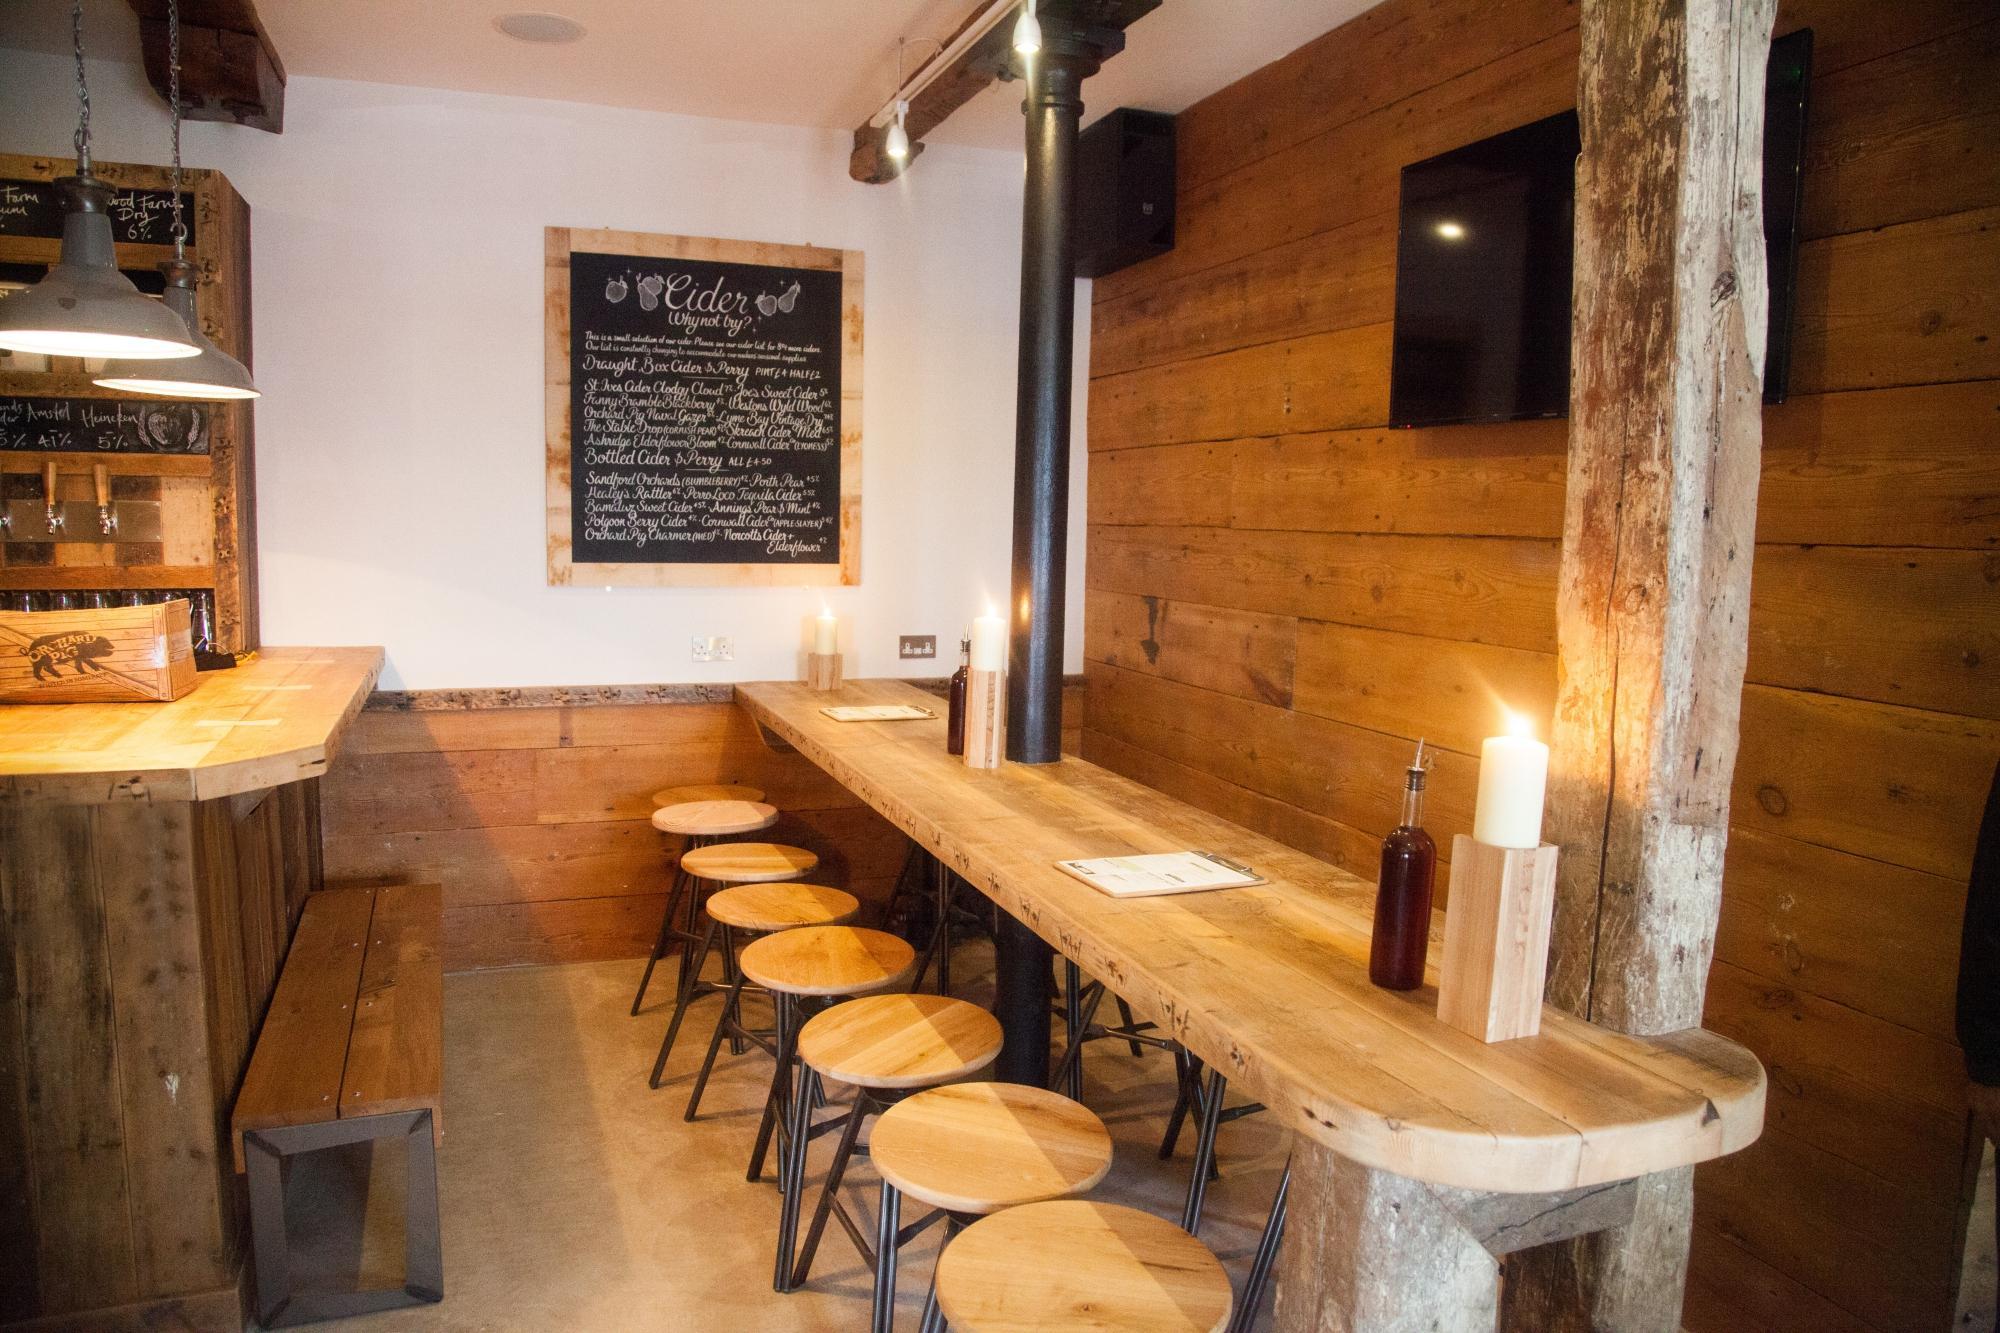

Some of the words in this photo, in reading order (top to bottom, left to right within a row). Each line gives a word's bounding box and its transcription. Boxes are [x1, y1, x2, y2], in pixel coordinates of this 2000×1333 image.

[117, 208, 160, 226] Dry
[128, 224, 152, 240] 6%
[665, 272, 749, 314] Cider
[668, 312, 700, 334] Why
[700, 313, 722, 328] not
[723, 314, 752, 336] try?
[585, 331, 599, 340] This
[614, 333, 630, 342] small
[632, 334, 657, 343] selection
[659, 334, 665, 344] of
[694, 336, 714, 346] Please
[738, 340, 753, 348] cider
[755, 340, 765, 350] list
[585, 341, 599, 350] Our
[601, 341, 612, 351] list
[620, 344, 651, 355] constantly
[652, 346, 678, 357] changing
[679, 346, 685, 354] to
[583, 354, 638, 378] Draught
[640, 356, 670, 374] Box
[671, 359, 702, 373] Cider
[713, 361, 749, 384] Perry
[755, 367, 776, 376] PINT
[789, 369, 810, 378] HALF
[600, 378, 623, 392] Ives
[624, 380, 651, 393] Cider
[653, 380, 689, 400] Clodgy
[691, 382, 724, 396] Cloud
[761, 384, 793, 398] Sweet
[793, 386, 818, 399] Cider
[619, 393, 661, 407] Bramble
[662, 393, 715, 412] Blackberry
[729, 396, 768, 411] Westons
[769, 399, 795, 416] Wyld
[797, 400, 824, 412] Wood
[28, 402, 70, 423] Amstel
[80, 403, 138, 428] Heineken
[584, 406, 624, 419] Orchard
[626, 407, 645, 425] Pig
[678, 409, 706, 426] Gazer
[716, 410, 745, 428] Lyme
[747, 411, 769, 428] Bay
[770, 412, 804, 430] Vintage
[804, 412, 824, 430] Dry
[584, 419, 601, 432] The
[602, 419, 636, 433] Stable
[637, 420, 663, 437] Drop
[767, 425, 792, 438] Cider
[98, 432, 128, 449] 5%
[584, 433, 631, 452] Ashridge
[633, 434, 687, 450] Elderflower
[687, 434, 717, 449] Bloom
[727, 436, 766, 449] Cornwall
[767, 438, 790, 450] Cider
[584, 447, 635, 465] Bottled
[638, 449, 670, 466] Cider
[683, 449, 723, 473] Perry
[729, 456, 745, 467] ALL
[586, 470, 636, 490] Sandford
[636, 472, 680, 486] Orchards
[682, 475, 741, 489] (BUMBLEBERRY)
[749, 473, 779, 487] Porth
[632, 486, 672, 499] Rattler
[683, 486, 711, 499] Perro
[712, 487, 736, 500] Loco
[737, 488, 775, 505] Tequila
[776, 488, 802, 501] Cider
[637, 500, 666, 512] Sweet
[668, 501, 693, 513] Cider
[754, 501, 777, 514] Pear
[787, 502, 811, 514] Mint
[585, 513, 626, 531] Polgoon
[627, 512, 659, 531] Berry
[661, 514, 688, 527] Cider
[702, 512, 745, 527] Cornwall
[746, 515, 768, 527] Cider
[585, 528, 627, 540] Orchard
[627, 527, 647, 548] Pig
[648, 526, 693, 541] Charmer
[763, 529, 787, 541] Cider
[766, 540, 820, 557] Elderflower
[29, 634, 96, 662] ORCHARD
[50, 646, 79, 663] PIG
